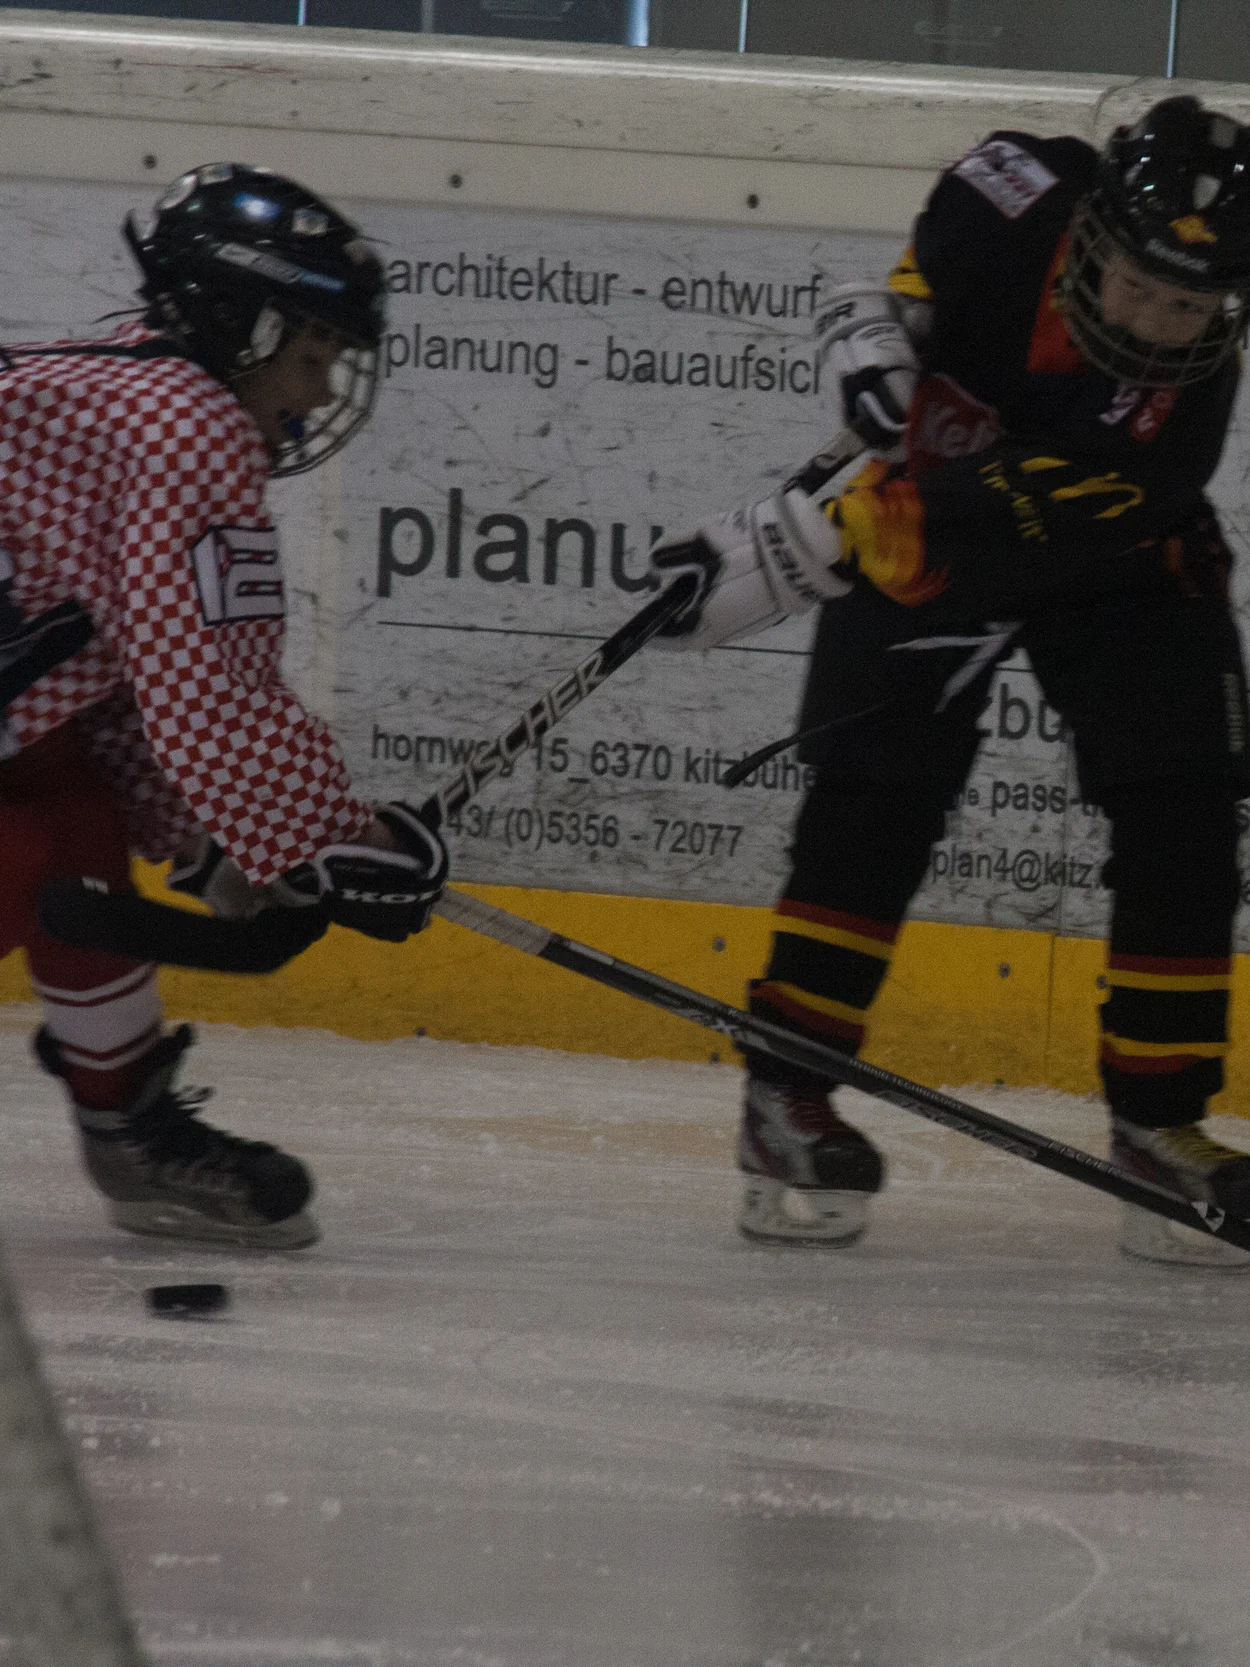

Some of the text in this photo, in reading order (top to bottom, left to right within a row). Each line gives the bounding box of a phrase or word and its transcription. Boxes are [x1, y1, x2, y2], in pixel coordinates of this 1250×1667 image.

[386, 252, 619, 306] architektur
[663, 272, 823, 318] entwurf
[384, 323, 559, 389] planung
[438, 650, 612, 822] FISCHER
[505, 806, 619, 852] (0)5356
[652, 817, 743, 858] 72077
